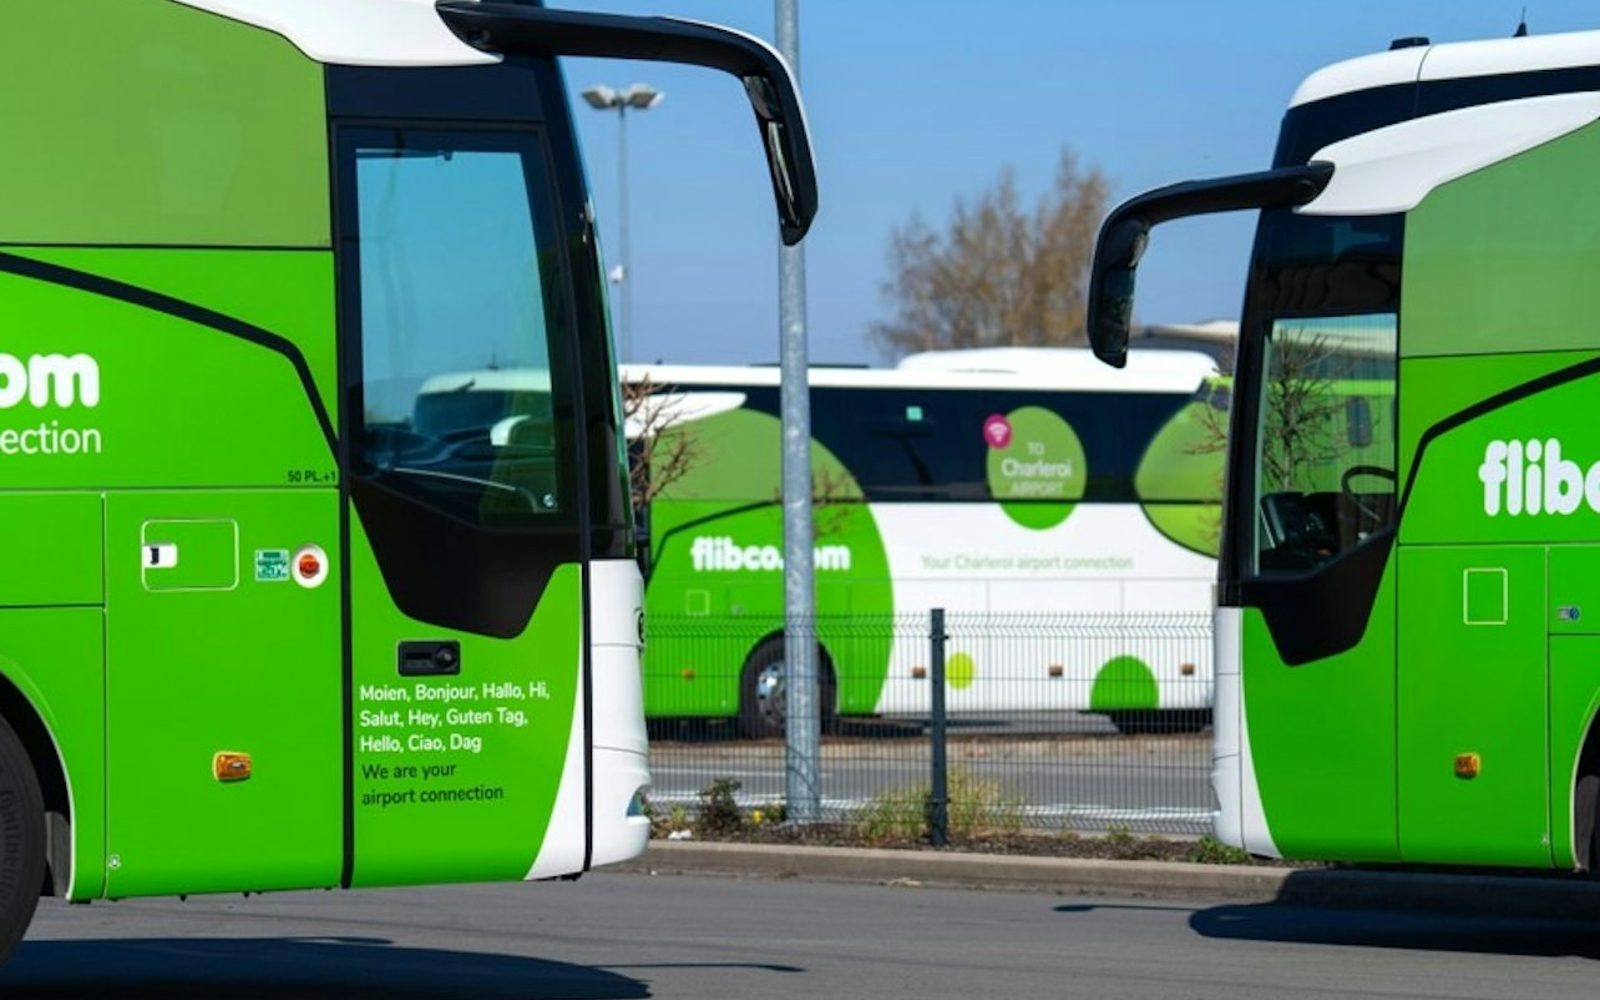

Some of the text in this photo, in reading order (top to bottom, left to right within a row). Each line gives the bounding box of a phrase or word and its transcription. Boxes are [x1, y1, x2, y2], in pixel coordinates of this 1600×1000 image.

[1026, 441, 1045, 456] TO
[288, 470, 302, 482] 50
[1001, 459, 1072, 478] Charleroi
[921, 553, 1135, 571] Your Charleroi airport connection
[359, 681, 551, 703] Moien, Bonjour, Hallo, Hi,
[360, 707, 528, 729] Salut, Hey, Guten Tag,
[360, 733, 483, 754] Hello, Ciao, Dag
[362, 763, 457, 780] We are your
[362, 784, 504, 808] airport connection
